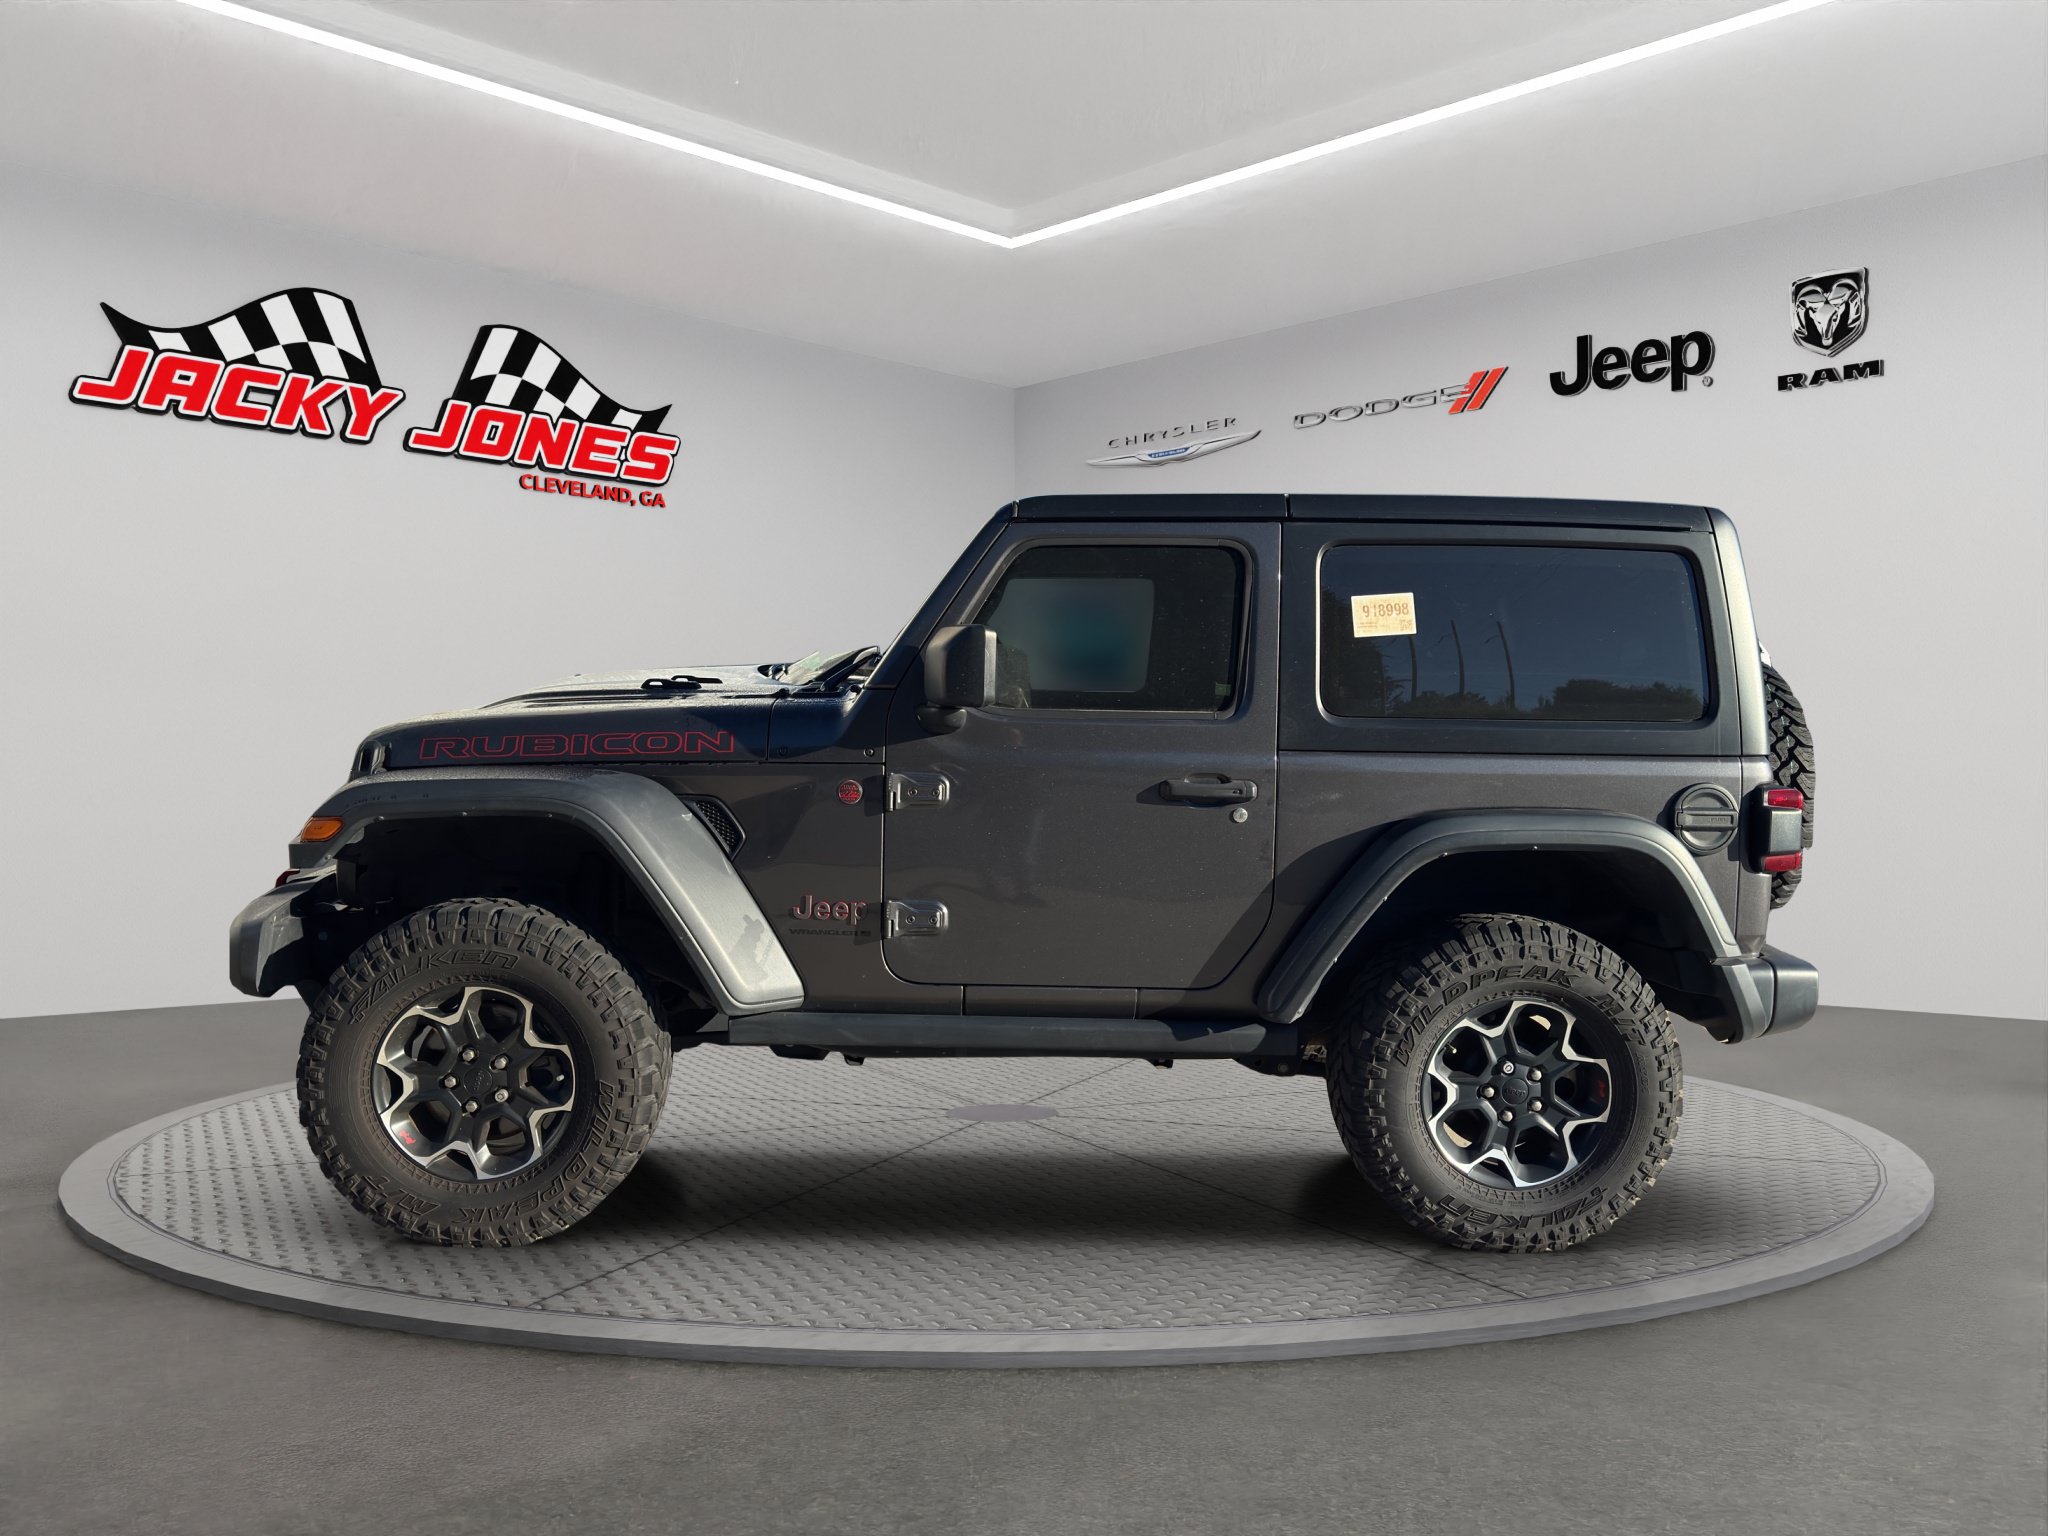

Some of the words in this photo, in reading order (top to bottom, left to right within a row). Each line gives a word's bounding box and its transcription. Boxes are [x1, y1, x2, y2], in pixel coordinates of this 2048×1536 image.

[1549, 331, 1715, 396] Jeep
[1778, 359, 1885, 391] RAM
[69, 344, 406, 444] JACKY
[404, 398, 680, 486] JONES
[1294, 383, 1471, 430] DODGE
[1108, 417, 1237, 449] CHRYSLER
[519, 473, 636, 507] CLEVELAND,
[639, 490, 666, 508] GA
[1362, 603, 1410, 618] 918998
[419, 731, 735, 760] RUBICON
[792, 895, 869, 926] Jeep
[789, 928, 858, 937] WRANGLER
[1395, 964, 1582, 1067] WILDPEAK
[451, 1079, 618, 1226] WILDPEAK
